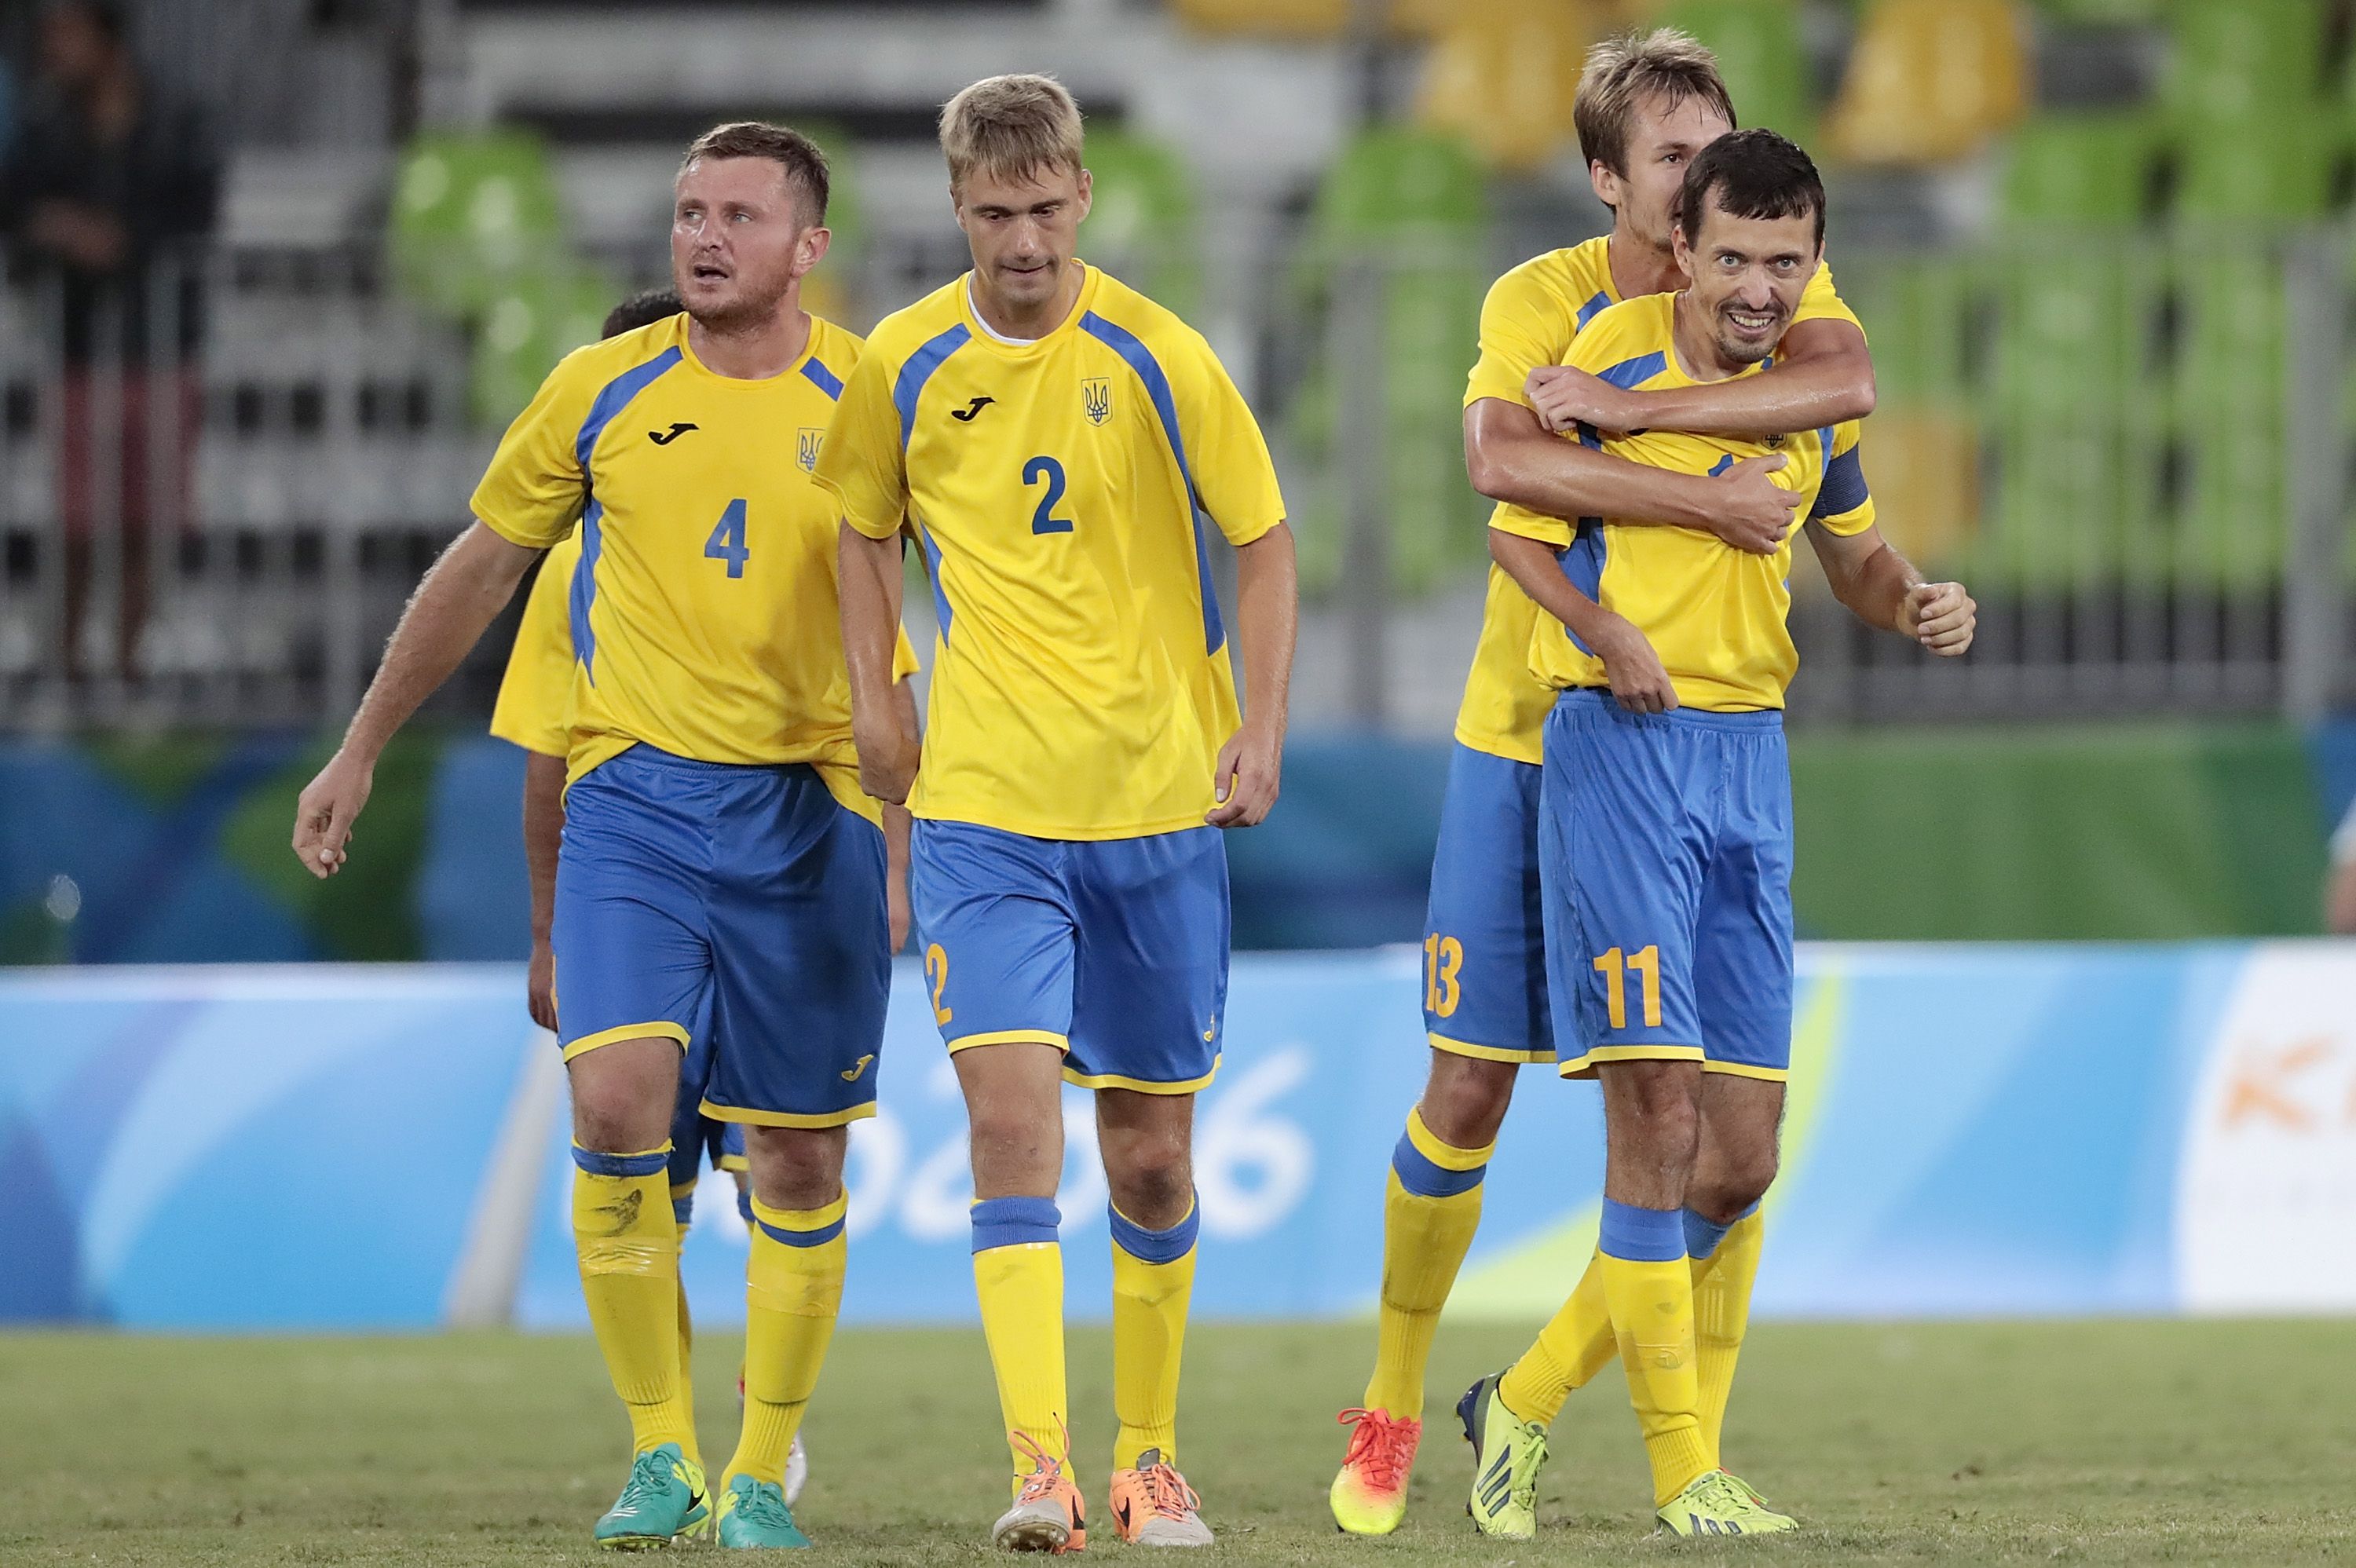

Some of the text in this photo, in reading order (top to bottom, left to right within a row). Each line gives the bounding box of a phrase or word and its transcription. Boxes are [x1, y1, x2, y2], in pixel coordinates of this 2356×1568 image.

[1022, 455, 1074, 535] 2
[704, 498, 750, 579] 4
[925, 942, 953, 1028] 2
[1424, 931, 1464, 1018] 13
[1592, 944, 1662, 1029] 11
